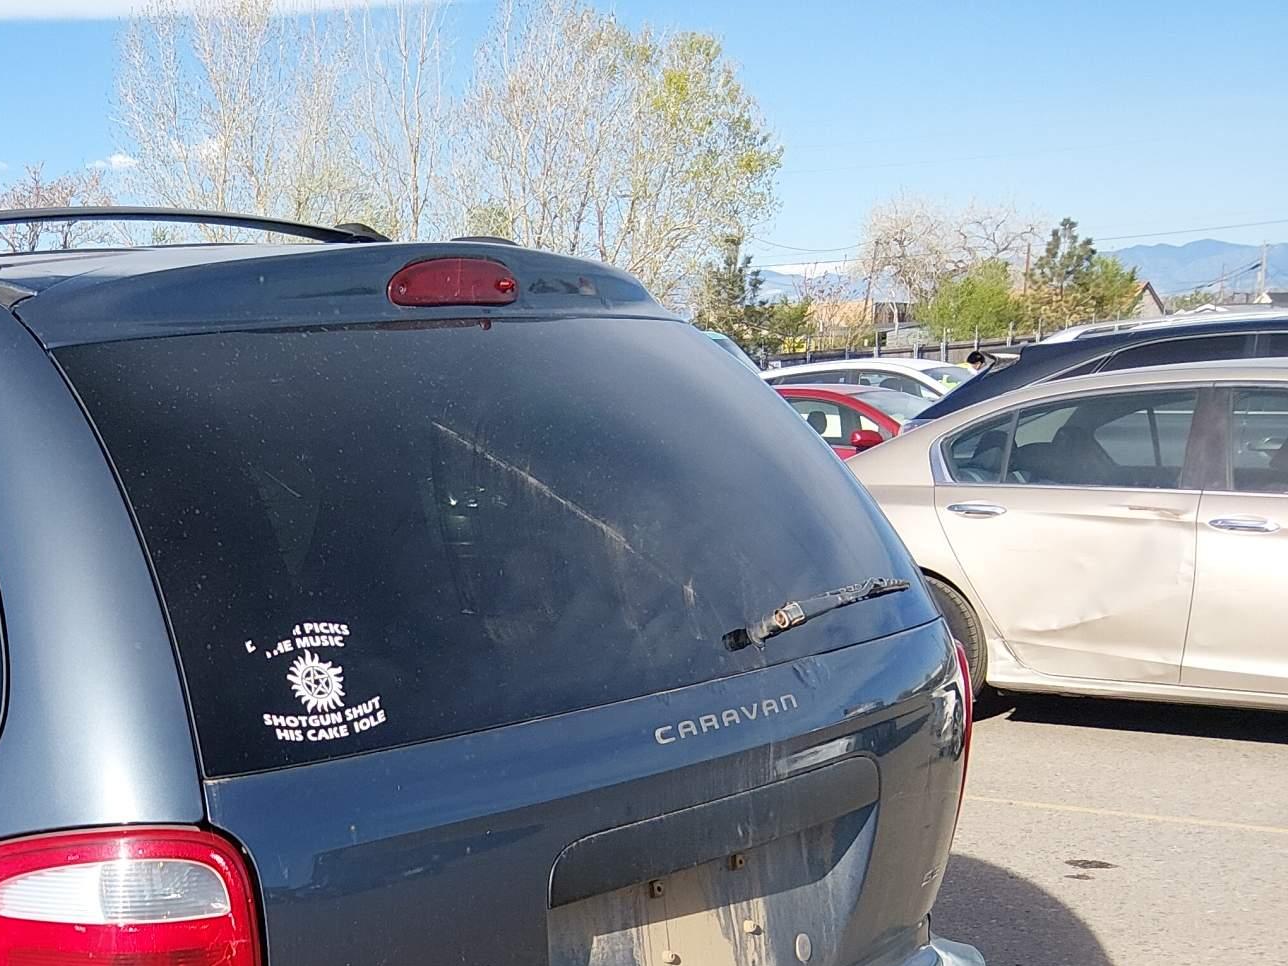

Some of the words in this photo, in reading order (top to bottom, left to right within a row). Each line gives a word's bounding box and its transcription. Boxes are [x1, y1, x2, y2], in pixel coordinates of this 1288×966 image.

[303, 622, 350, 636] PICKS
[296, 635, 345, 649] MUSIC
[263, 712, 343, 728] SHOTGUN
[345, 696, 381, 721] SHUT
[654, 693, 798, 745] CARAVAN
[275, 728, 304, 742] HIS
[306, 725, 350, 742] CAKE
